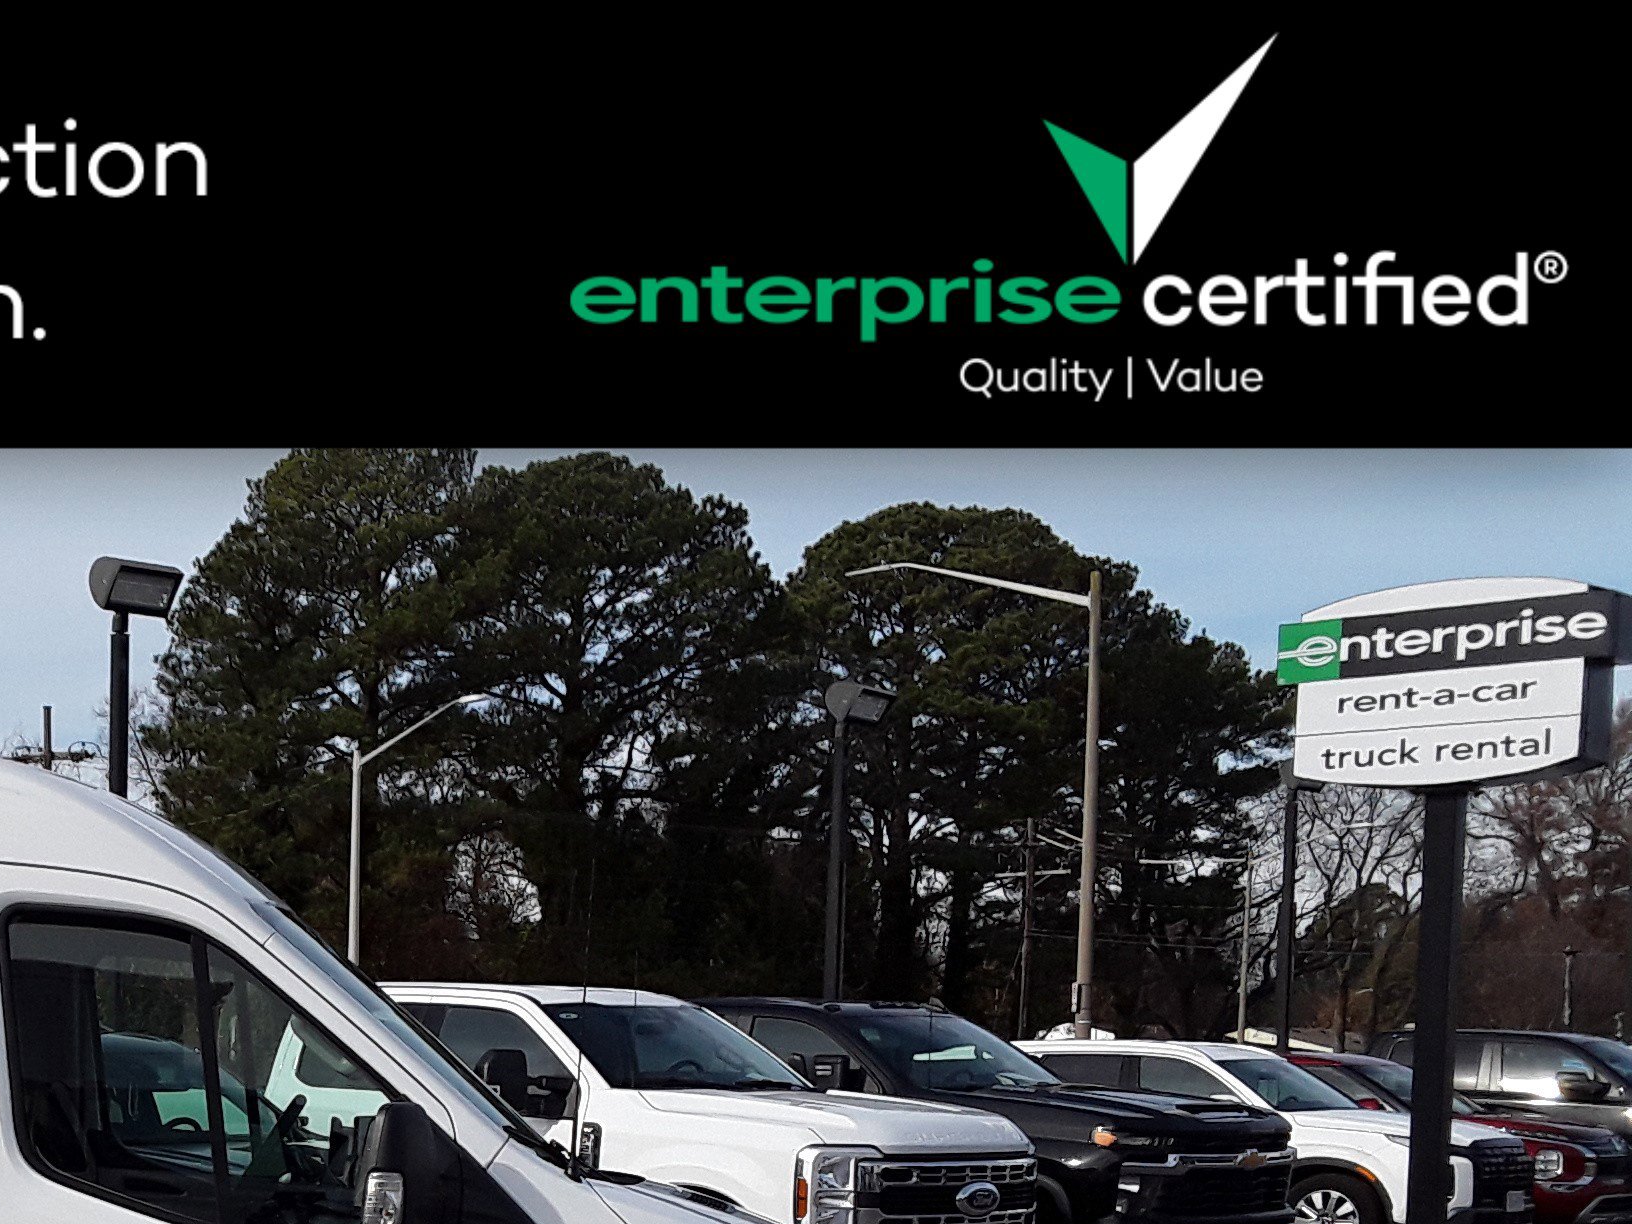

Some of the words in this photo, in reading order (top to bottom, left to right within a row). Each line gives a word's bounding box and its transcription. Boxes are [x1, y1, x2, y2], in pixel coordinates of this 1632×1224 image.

[1279, 608, 1608, 668] enterprise
[1337, 678, 1537, 714] rent-a-car
[1321, 738, 1420, 770] truck
[1435, 728, 1552, 762] rental
